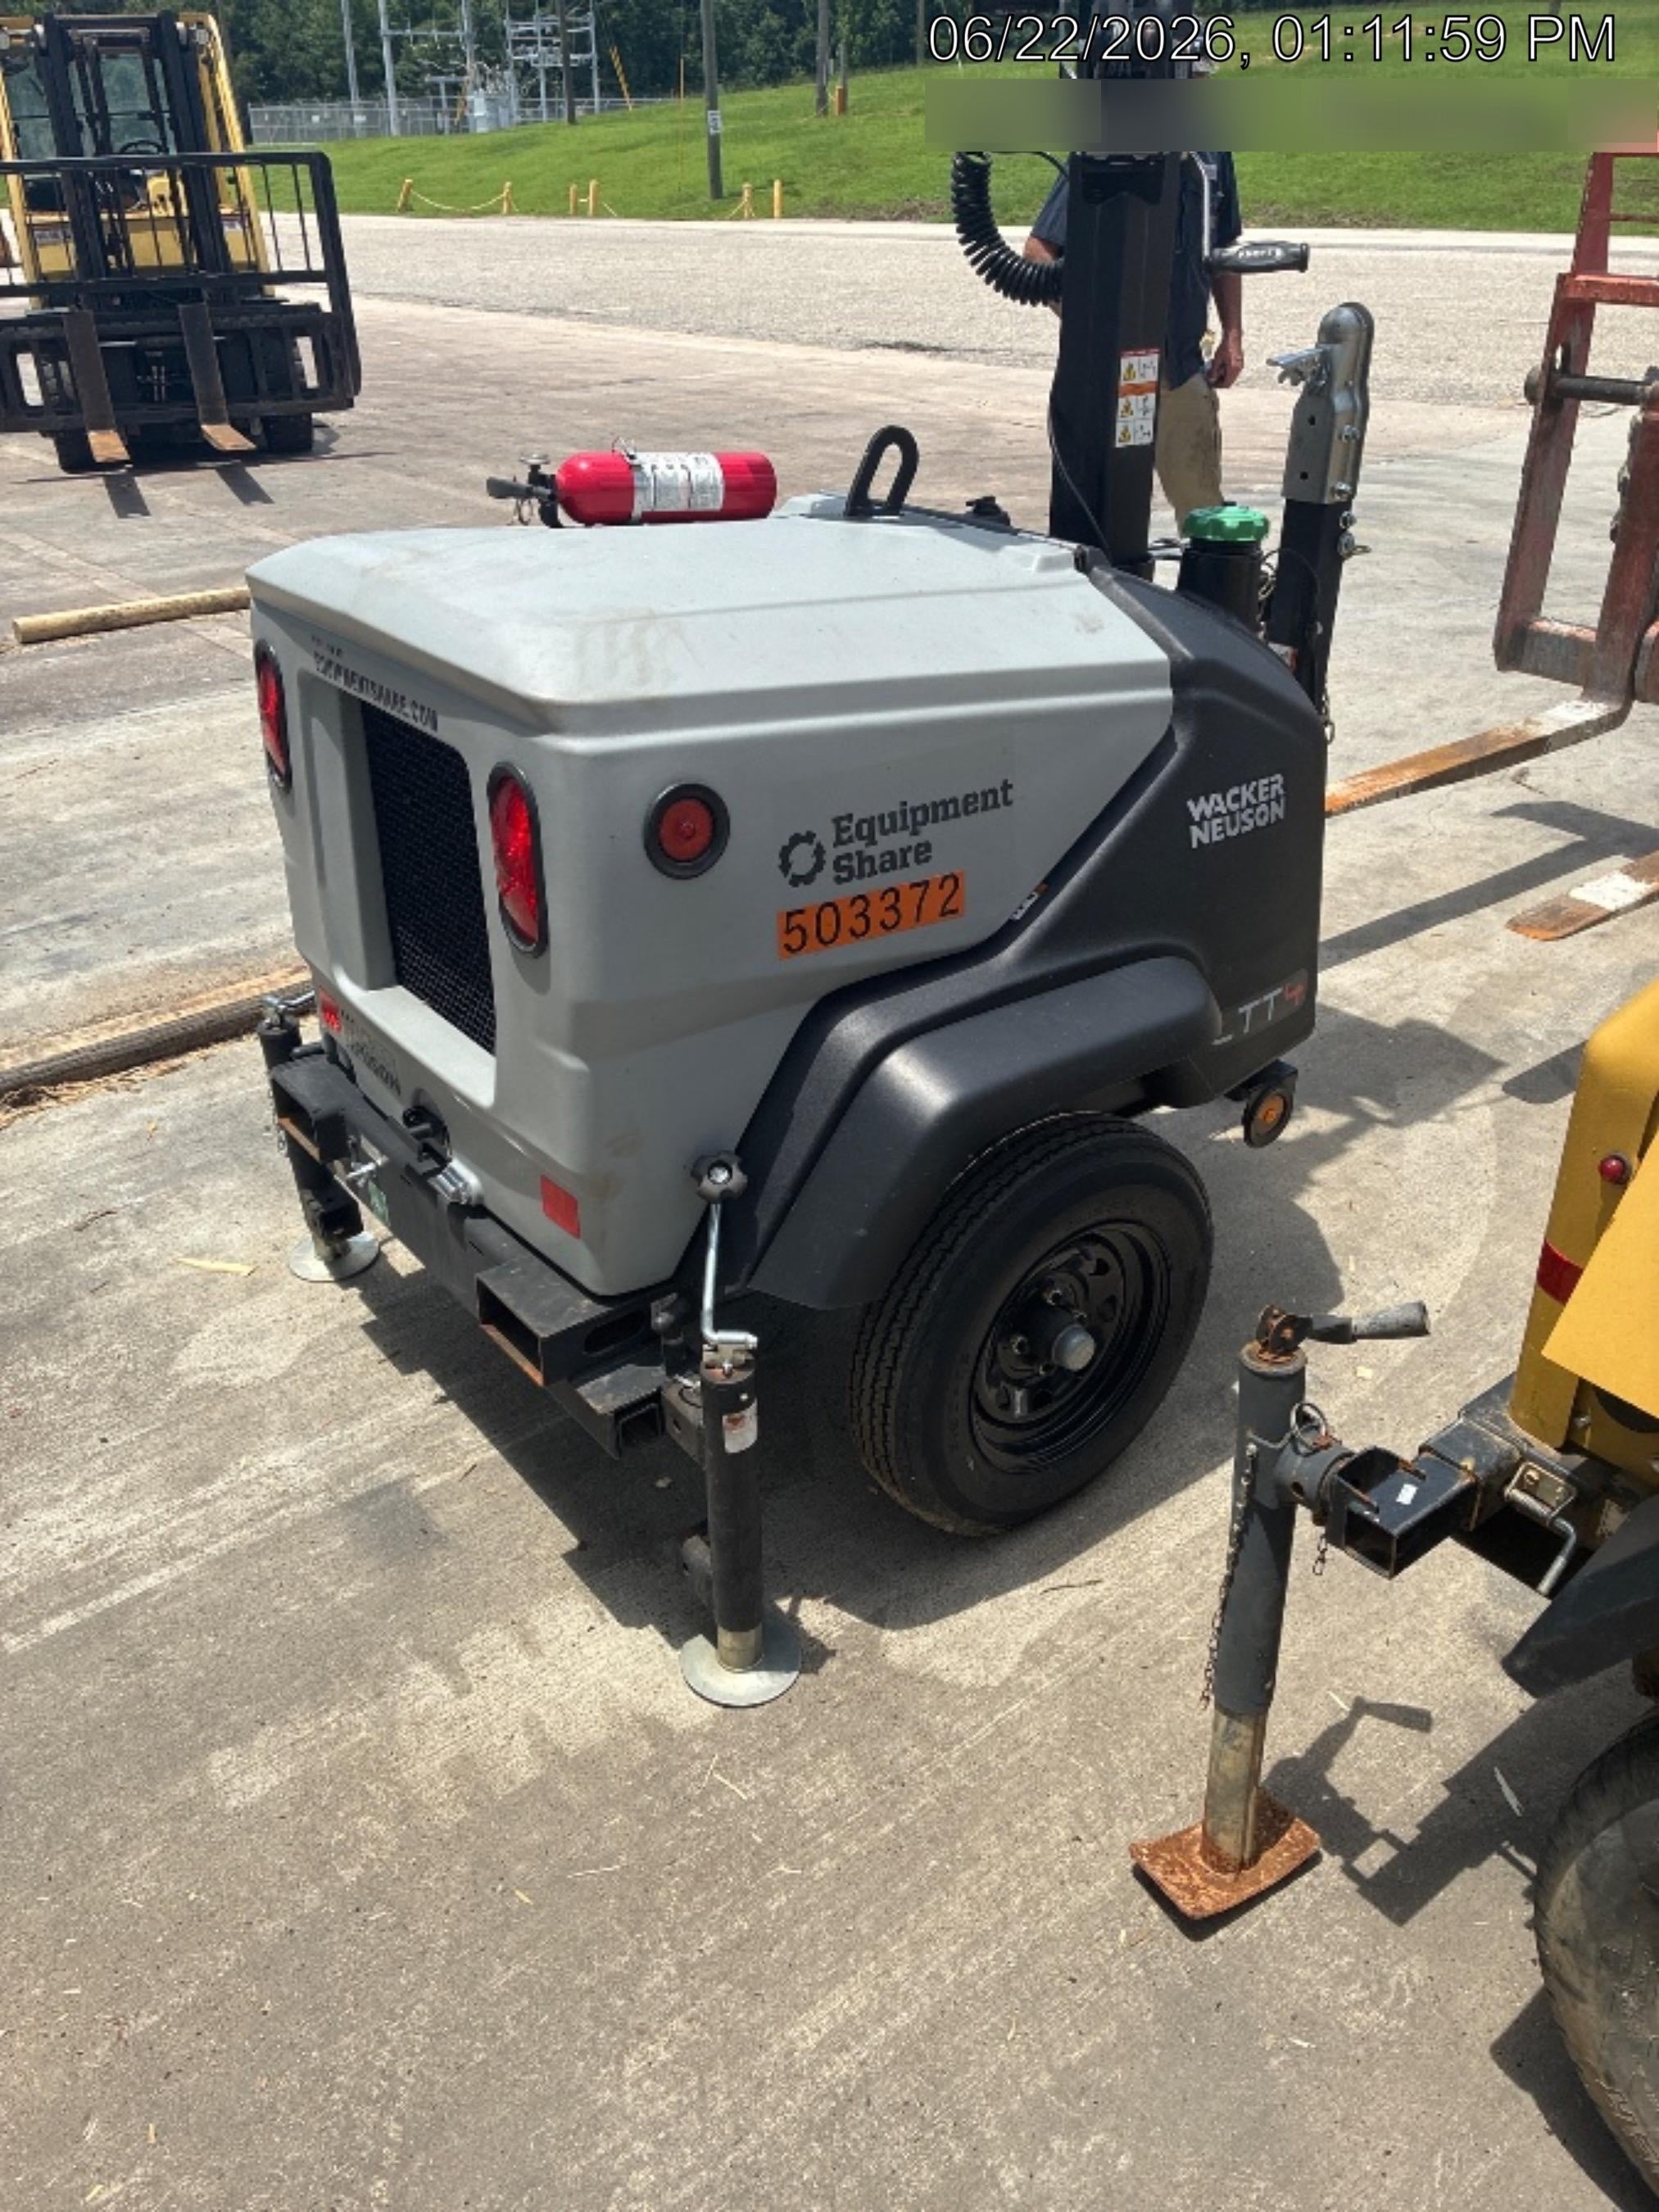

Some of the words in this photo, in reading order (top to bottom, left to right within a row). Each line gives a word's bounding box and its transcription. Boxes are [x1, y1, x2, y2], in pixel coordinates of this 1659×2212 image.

[831, 778, 1013, 848] Equipment
[1186, 773, 1285, 822] WACKER
[1189, 794, 1284, 849] NEUSON
[832, 840, 933, 886] Share
[783, 872, 959, 954] 503372
